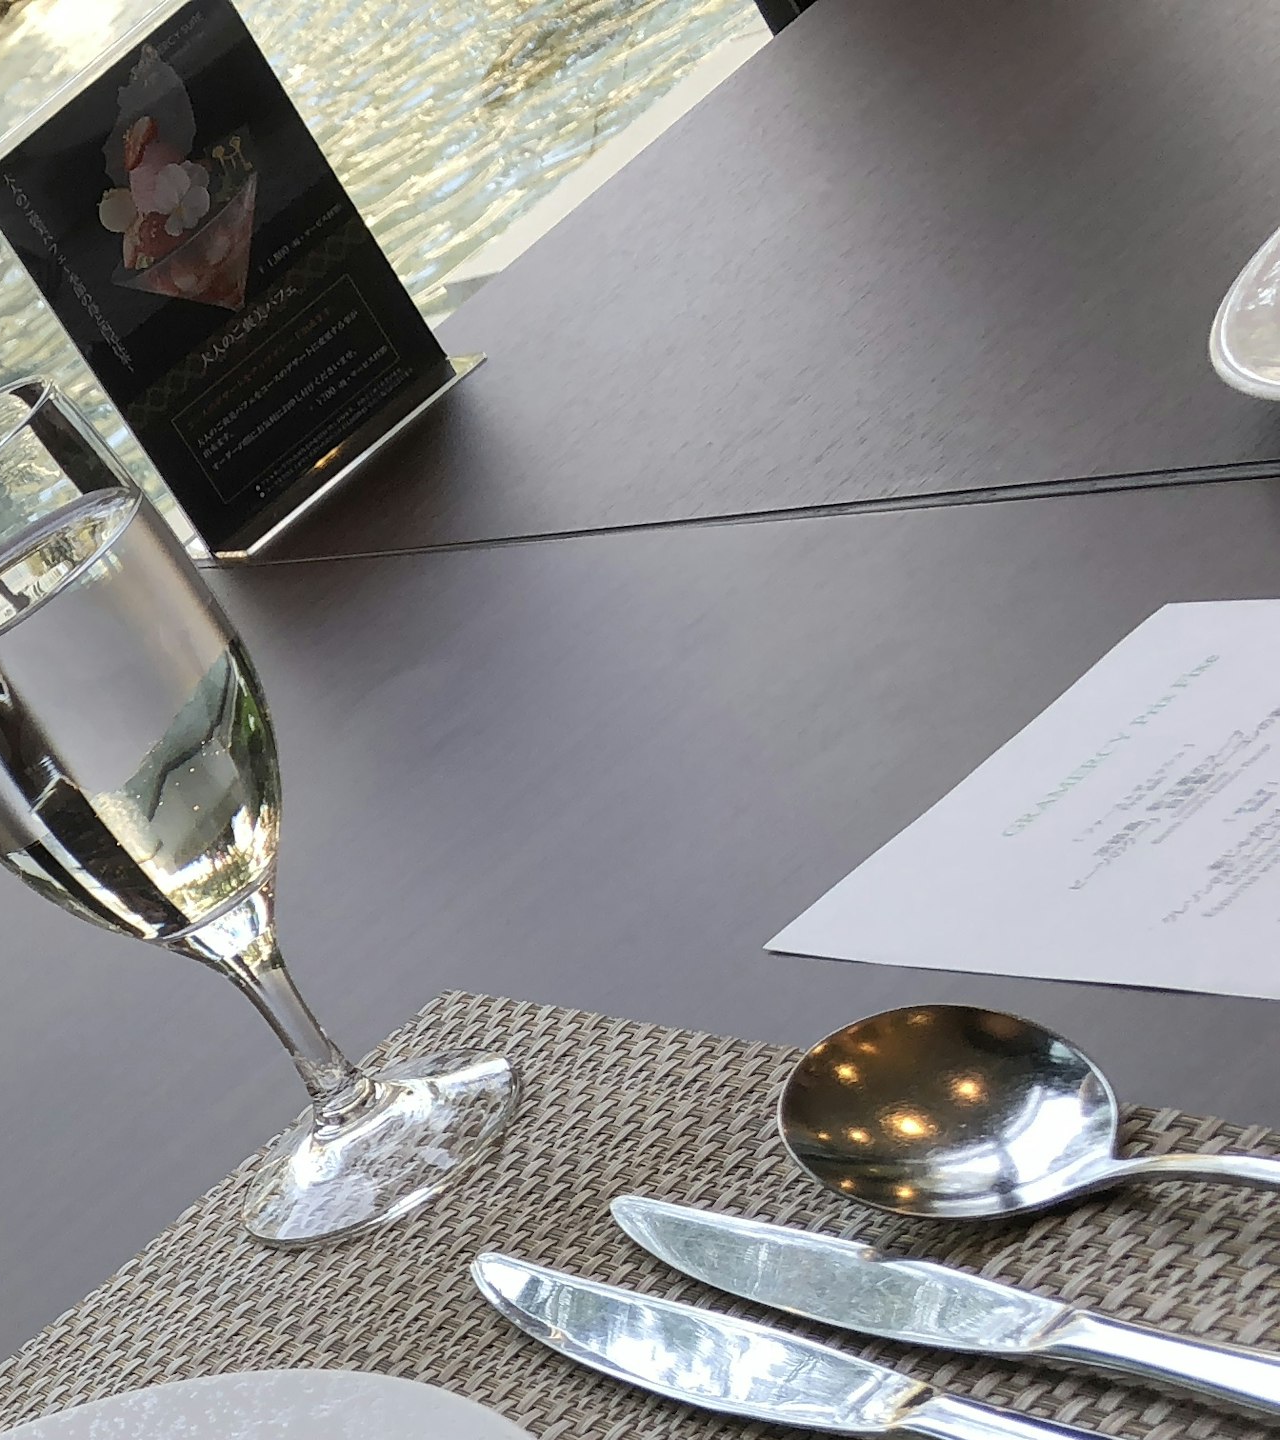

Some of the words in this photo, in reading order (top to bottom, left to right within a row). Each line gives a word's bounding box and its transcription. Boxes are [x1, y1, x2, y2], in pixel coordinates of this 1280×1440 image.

[200, 287, 299, 368] 大人のご褒美パフェ
[1002, 732, 1131, 837] GRAMERCY
